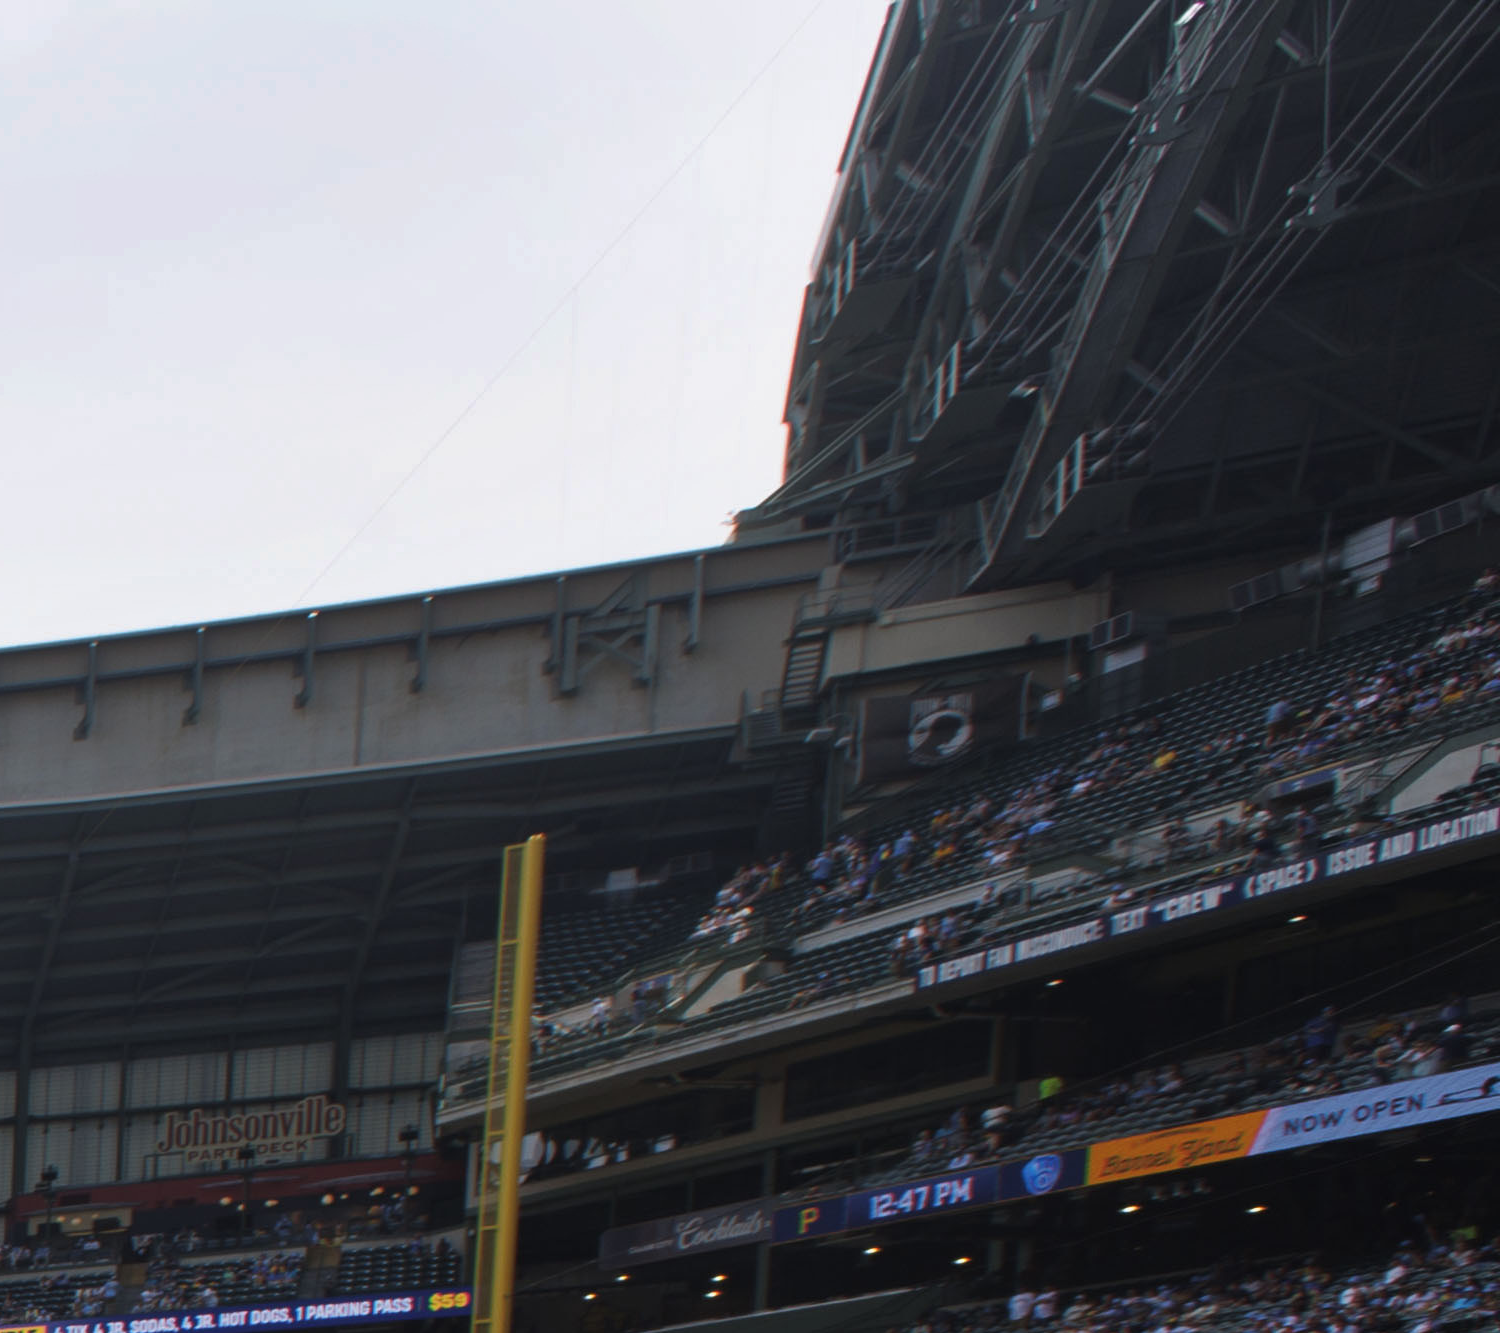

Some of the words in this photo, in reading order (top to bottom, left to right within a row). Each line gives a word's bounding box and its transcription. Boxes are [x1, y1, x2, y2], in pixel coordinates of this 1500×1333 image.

[1325, 841, 1378, 877] ISSUE
[1377, 831, 1417, 862] AND
[1417, 808, 1500, 852] LOCATION
[157, 1095, 347, 1153] Johnsonville
[1282, 1107, 1347, 1138] NOW
[1353, 1092, 1425, 1123] OPEN
